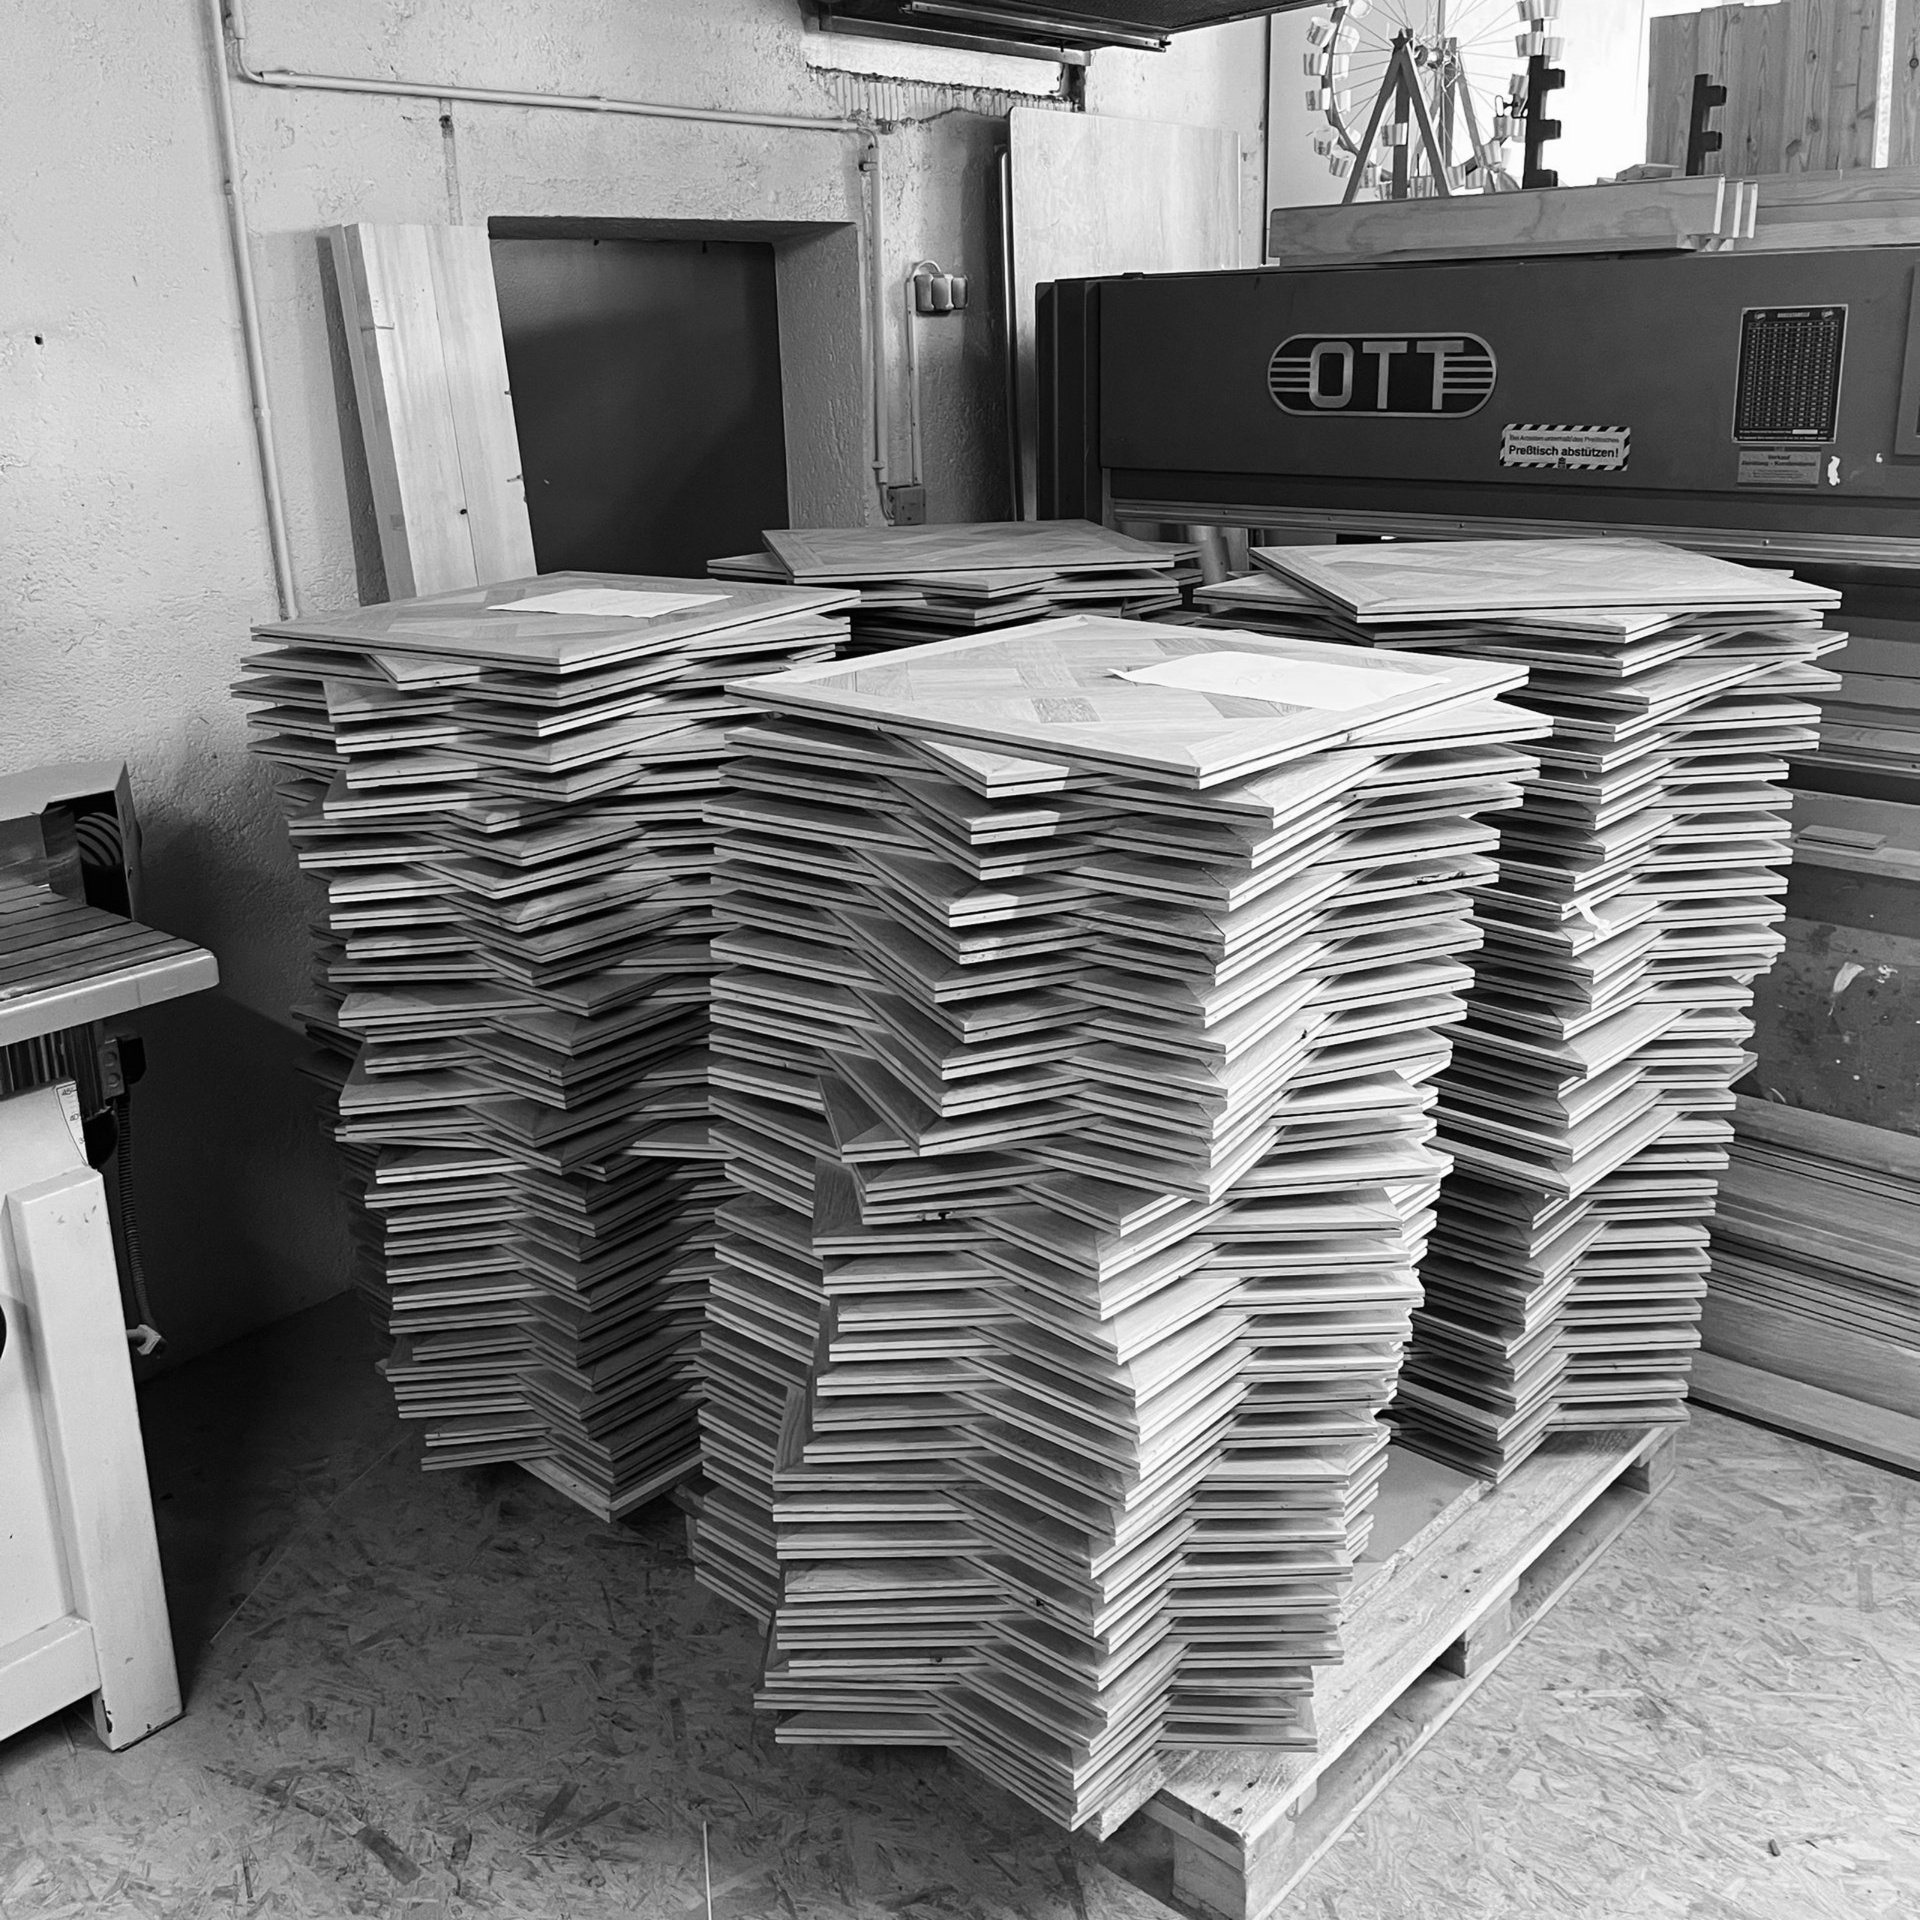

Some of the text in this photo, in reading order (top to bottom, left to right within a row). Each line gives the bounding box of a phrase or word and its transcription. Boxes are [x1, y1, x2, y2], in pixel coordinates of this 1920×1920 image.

[1309, 340, 1464, 410] OTT
[1508, 445, 1619, 458] Preßtisch abstützen!
